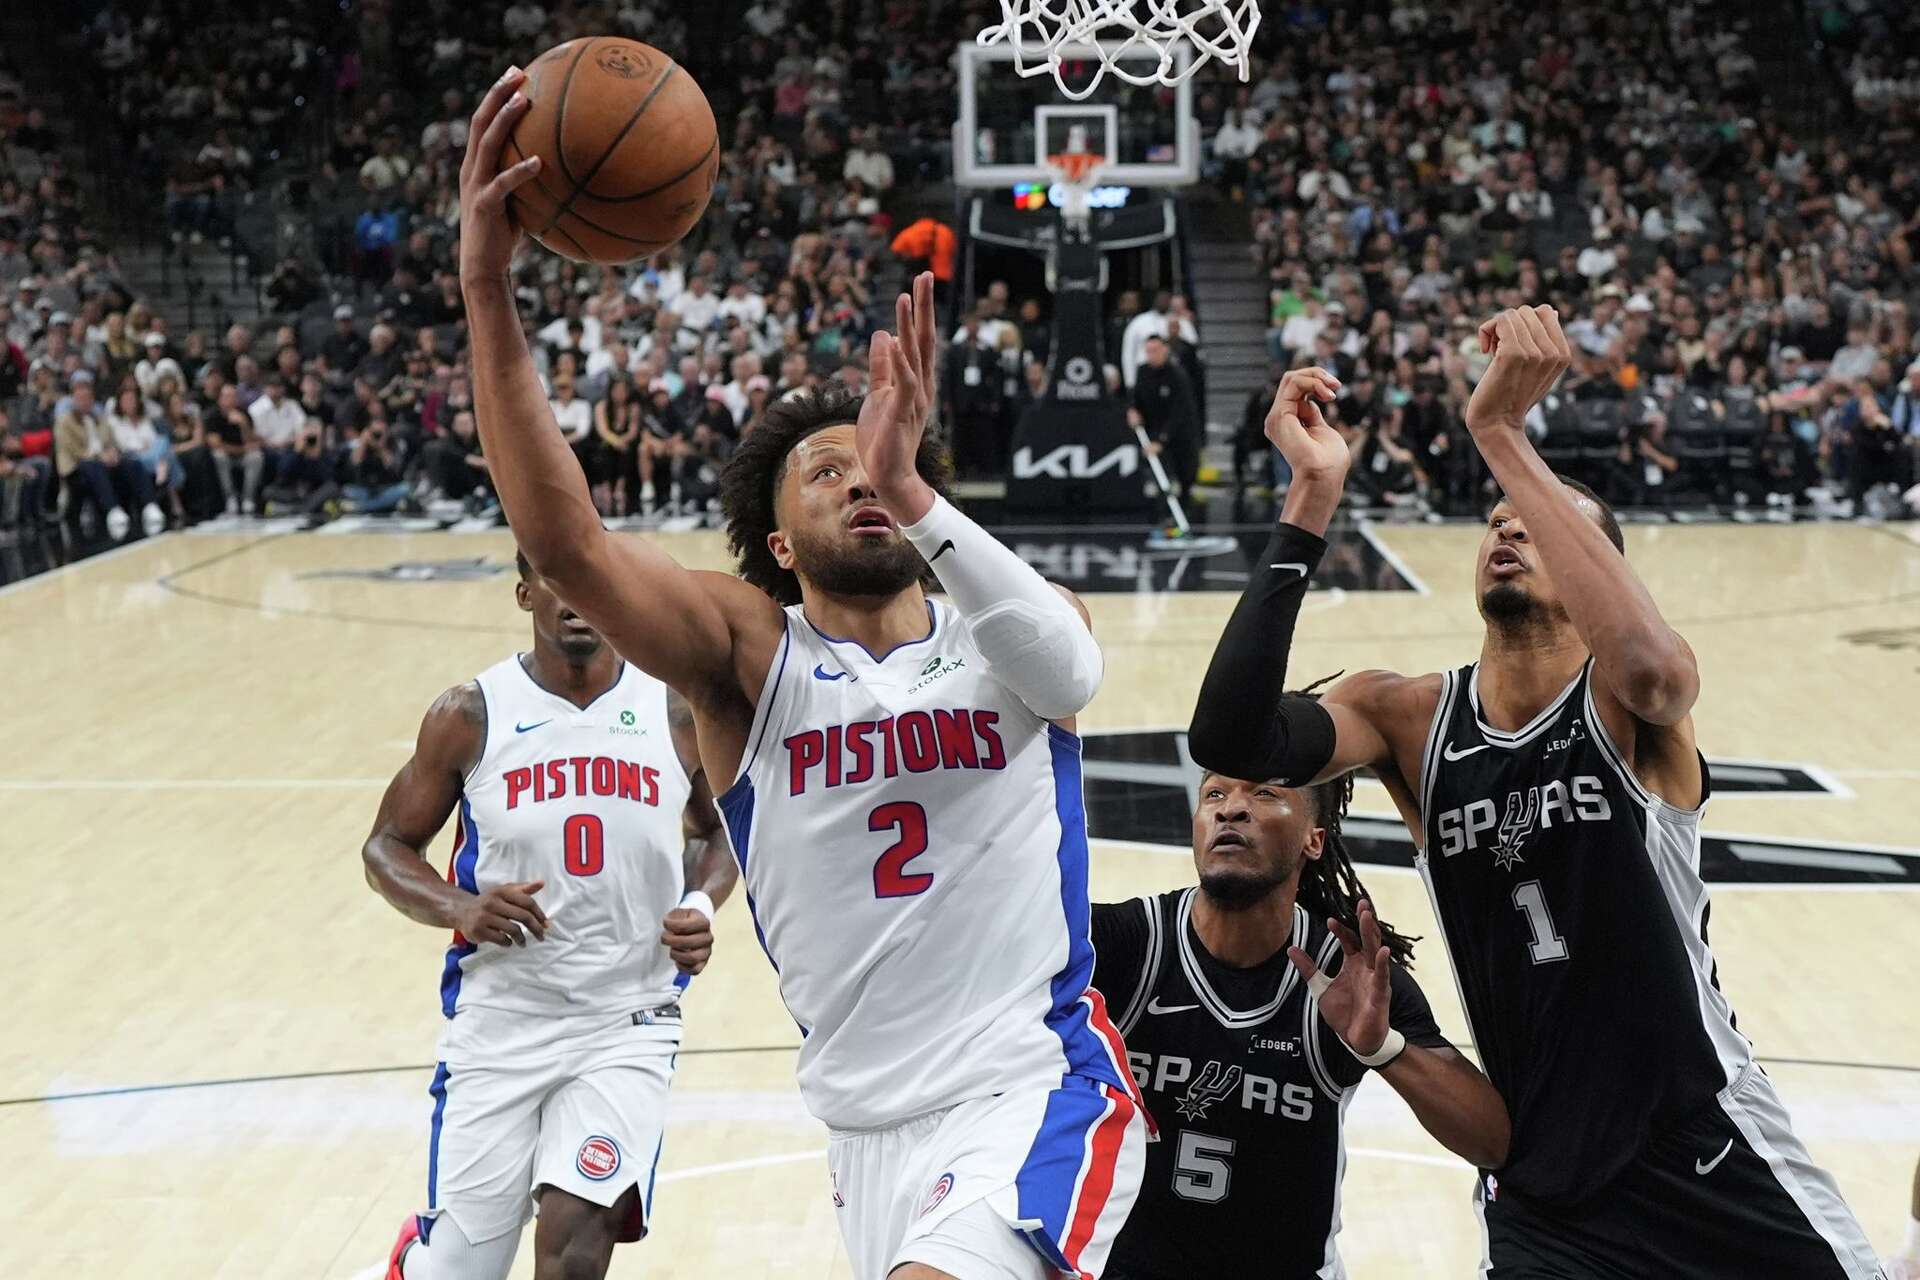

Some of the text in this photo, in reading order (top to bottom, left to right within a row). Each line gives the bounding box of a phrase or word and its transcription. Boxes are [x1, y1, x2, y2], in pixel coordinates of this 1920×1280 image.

[502, 756, 661, 810] PISTONS
[783, 708, 1008, 798] PISTONS
[563, 813, 604, 877] 0
[867, 800, 935, 900] 2
[1437, 775, 1612, 873] SPURS
[1511, 879, 1570, 966] 1
[1254, 1038, 1294, 1052] LEDGER
[1127, 1050, 1314, 1122] SPURS
[1171, 1128, 1237, 1204] 5
